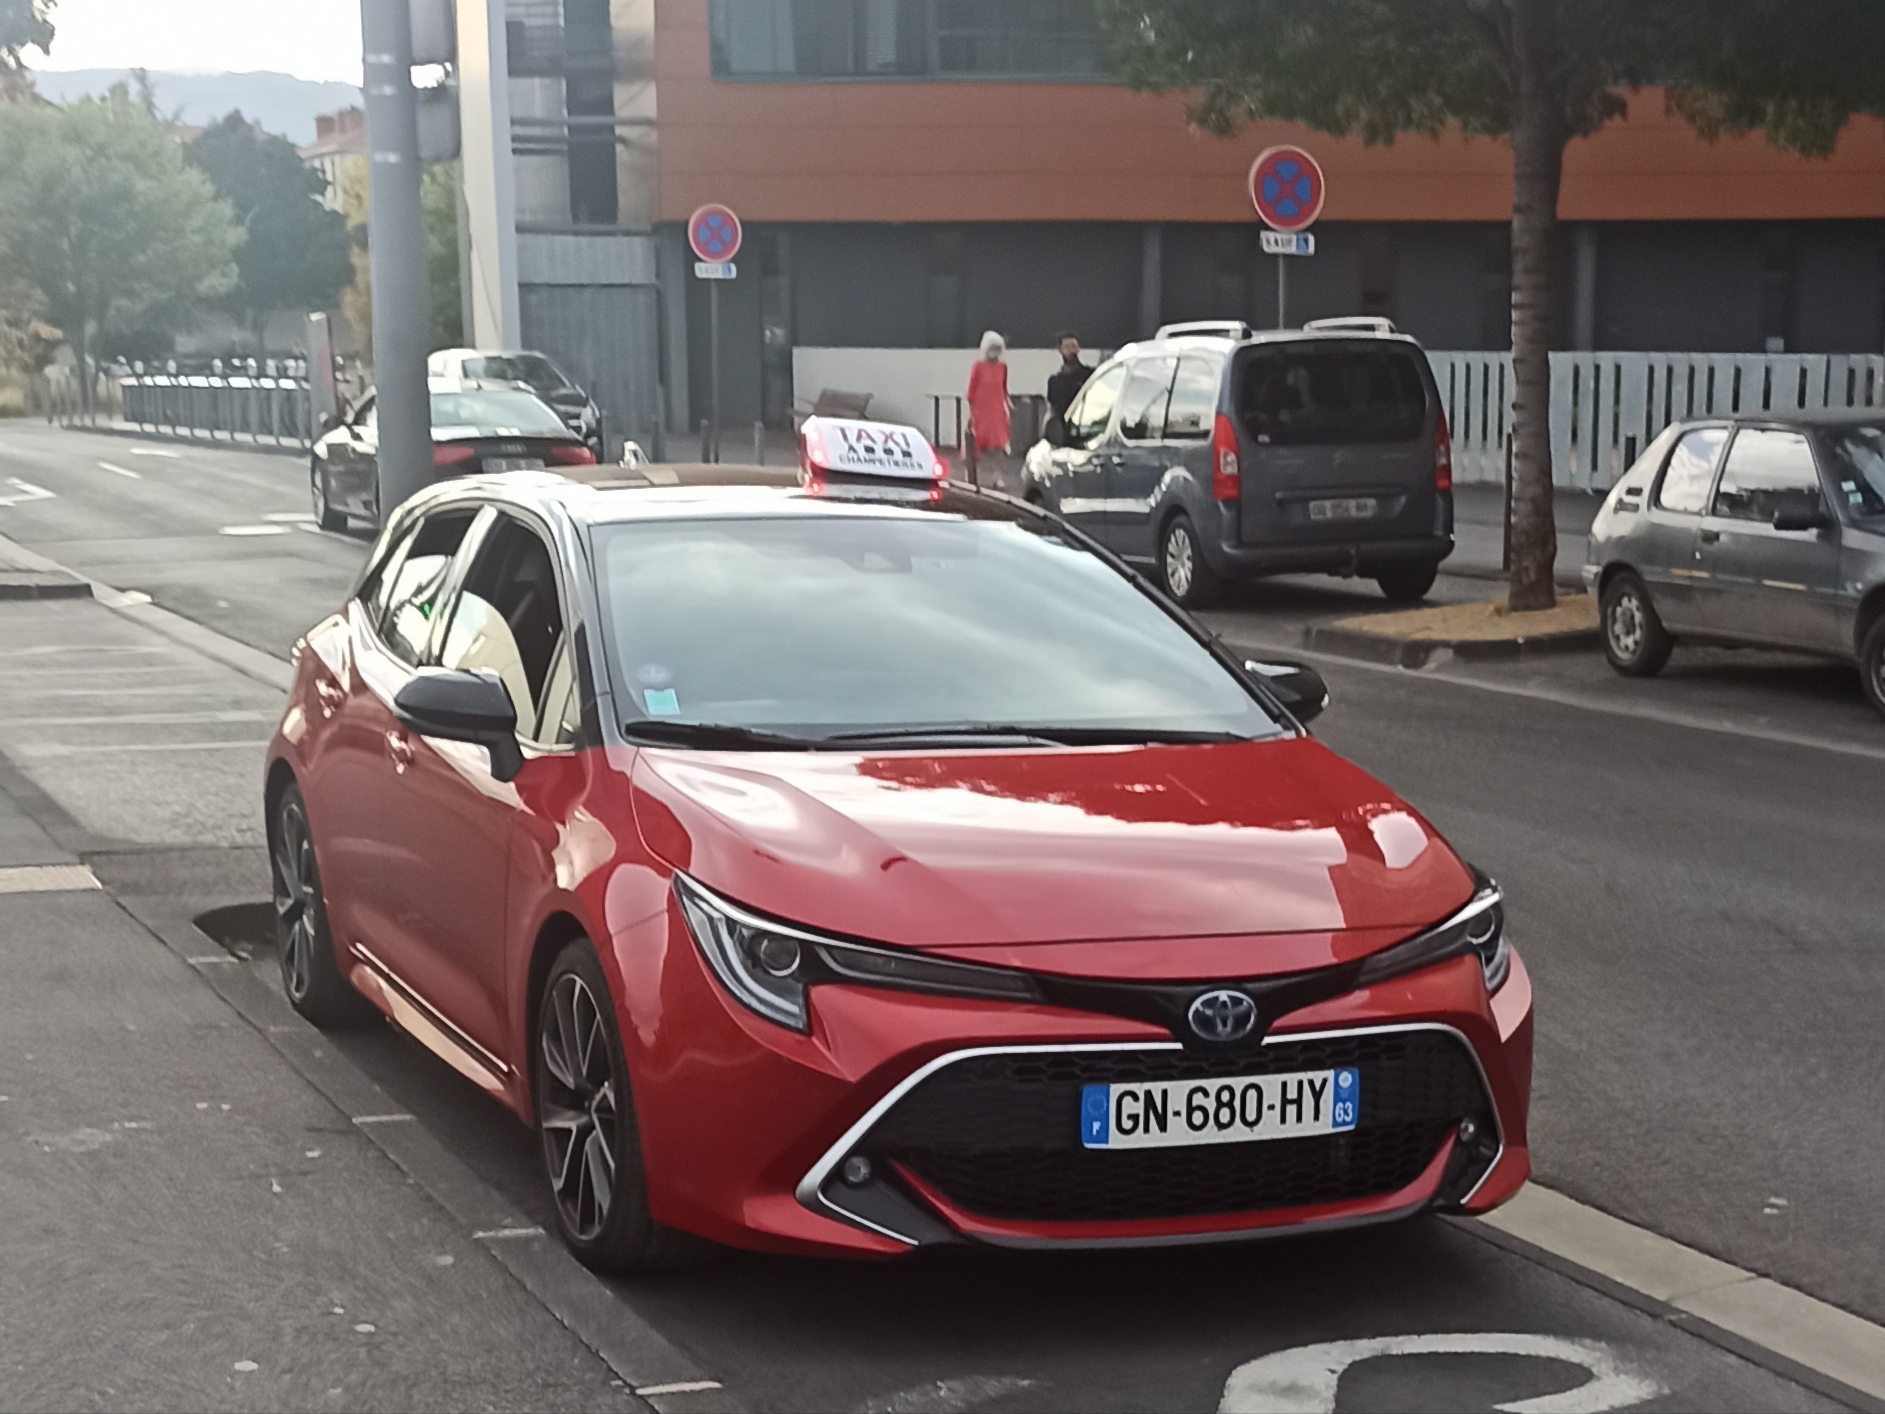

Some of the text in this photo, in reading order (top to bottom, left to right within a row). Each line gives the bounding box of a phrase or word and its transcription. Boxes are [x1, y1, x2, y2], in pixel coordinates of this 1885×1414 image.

[835, 426, 911, 449] TAXI
[1092, 1077, 1353, 1136] F GN-680-HY 63
